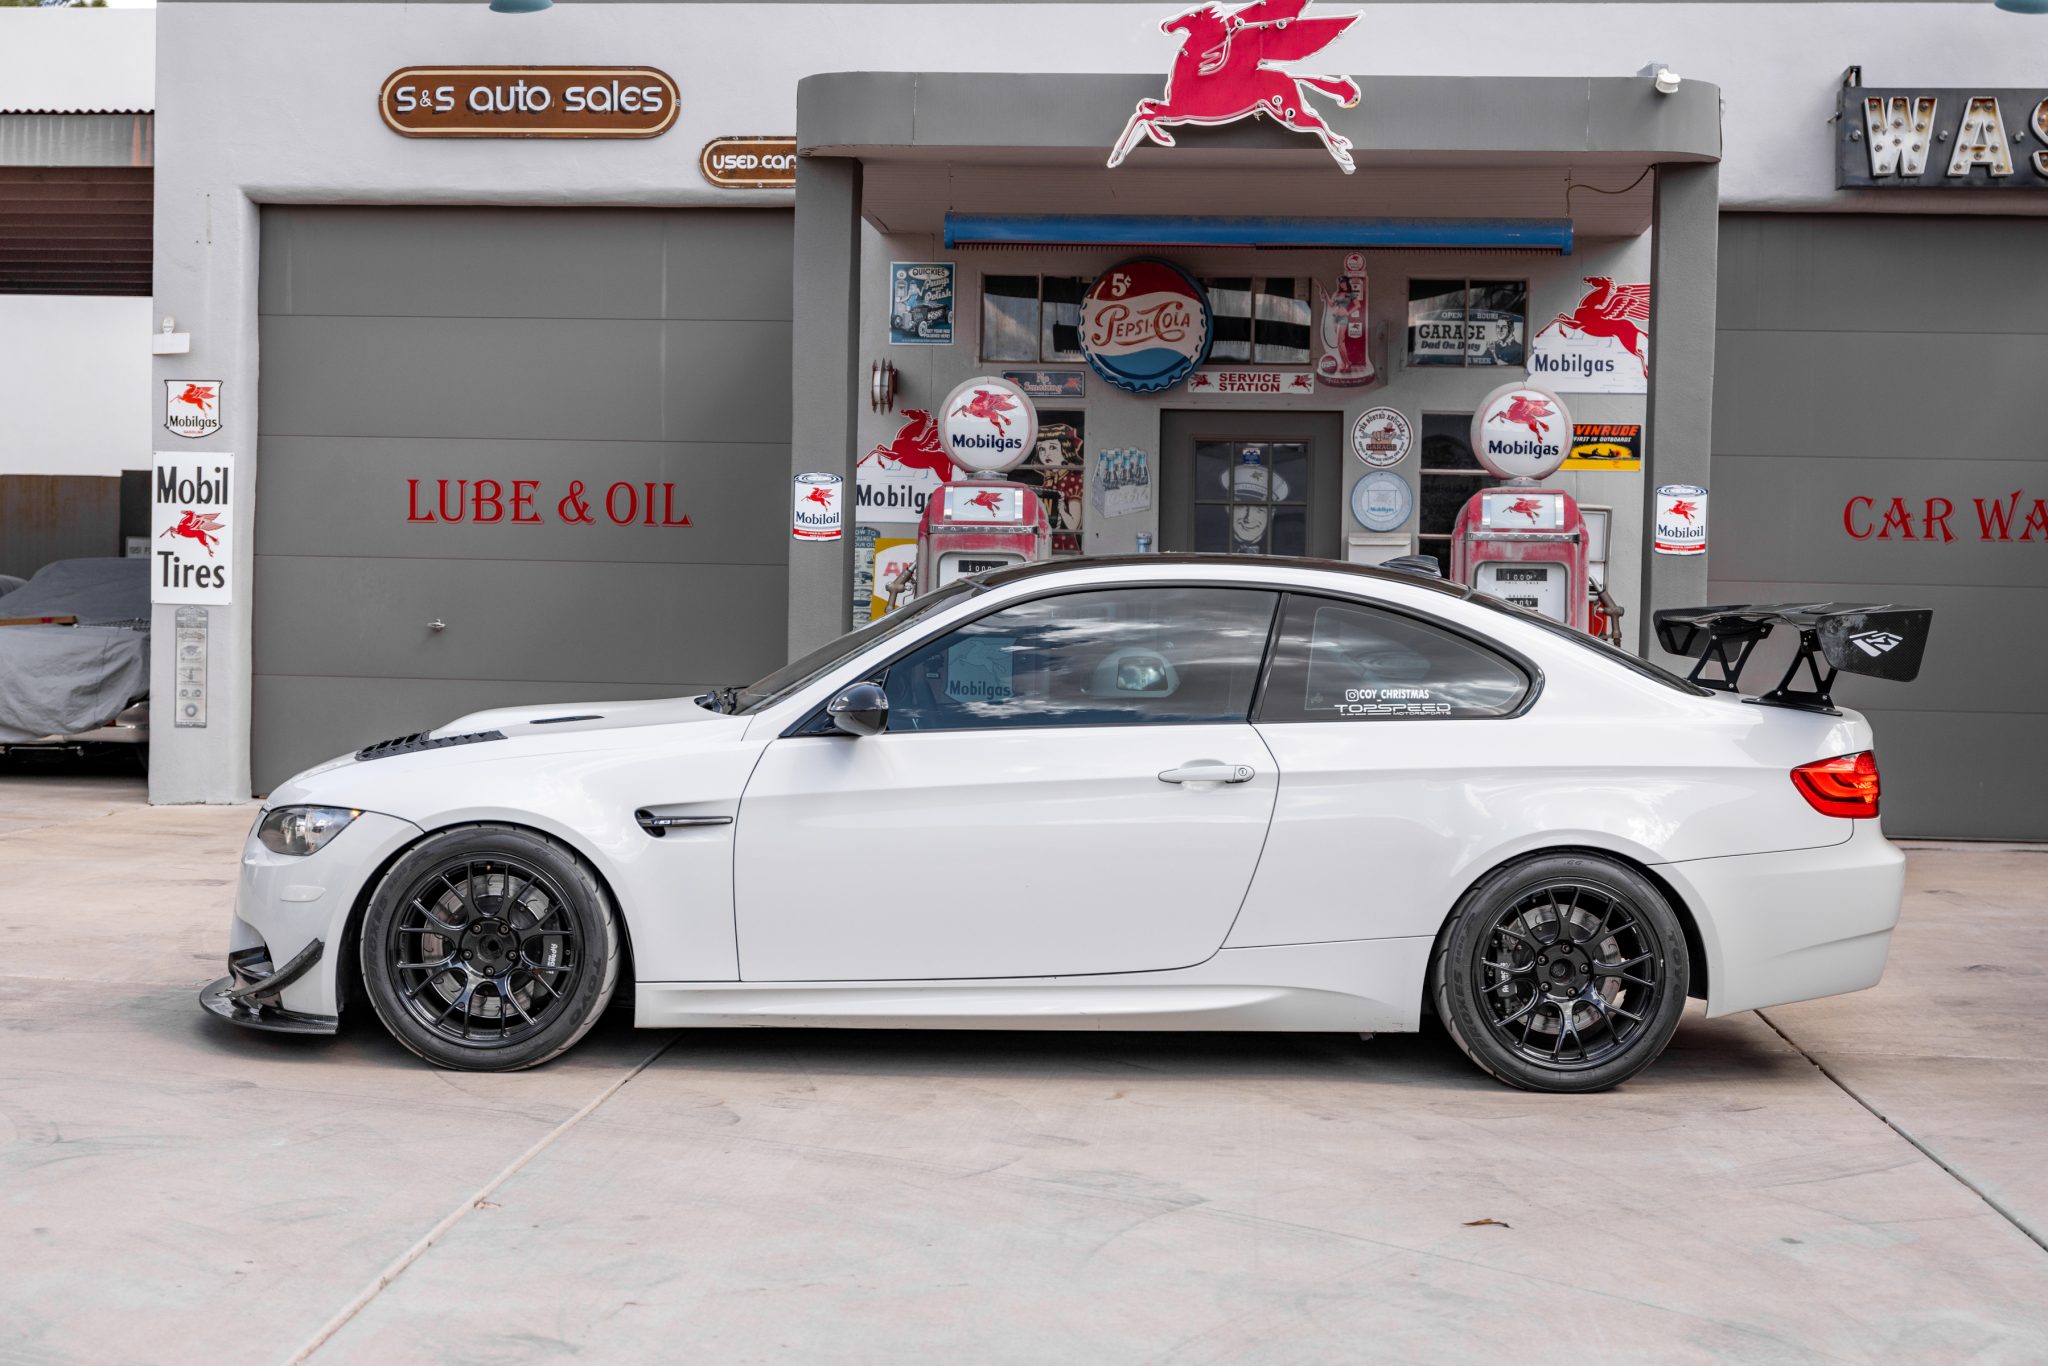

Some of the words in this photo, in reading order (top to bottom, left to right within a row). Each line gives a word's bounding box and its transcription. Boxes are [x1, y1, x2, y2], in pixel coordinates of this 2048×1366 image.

[469, 79, 550, 112] auto
[565, 80, 663, 112] sales
[712, 154, 758, 170] USED
[912, 268, 945, 277] QUICKIES
[1111, 273, 1132, 297] 5¢
[1441, 311, 1463, 319] OPEN
[1418, 324, 1486, 340] GARAGE
[1421, 341, 1440, 349] Dad
[1442, 341, 1456, 349] On
[1534, 354, 1615, 377] Mobilgas
[1219, 373, 1281, 382] SERVICE
[1219, 383, 1281, 392] STATION
[170, 415, 218, 430] Mobilgas
[952, 434, 1022, 453] Mobilgas
[1488, 440, 1560, 459] Mobilgas
[157, 466, 229, 505] Mobil
[406, 479, 545, 525] LUBE
[557, 480, 596, 526] &
[605, 481, 693, 528] OIL
[856, 484, 931, 514] Mobilg
[796, 511, 840, 525] Mobiloil
[1843, 495, 1959, 545] CAR
[1658, 524, 1704, 538] Mobiloil
[157, 551, 225, 589] Tires
[950, 680, 1011, 699] Mobilgas
[1334, 703, 1451, 714] TOPSPEED
[567, 957, 602, 1026] TOYO
